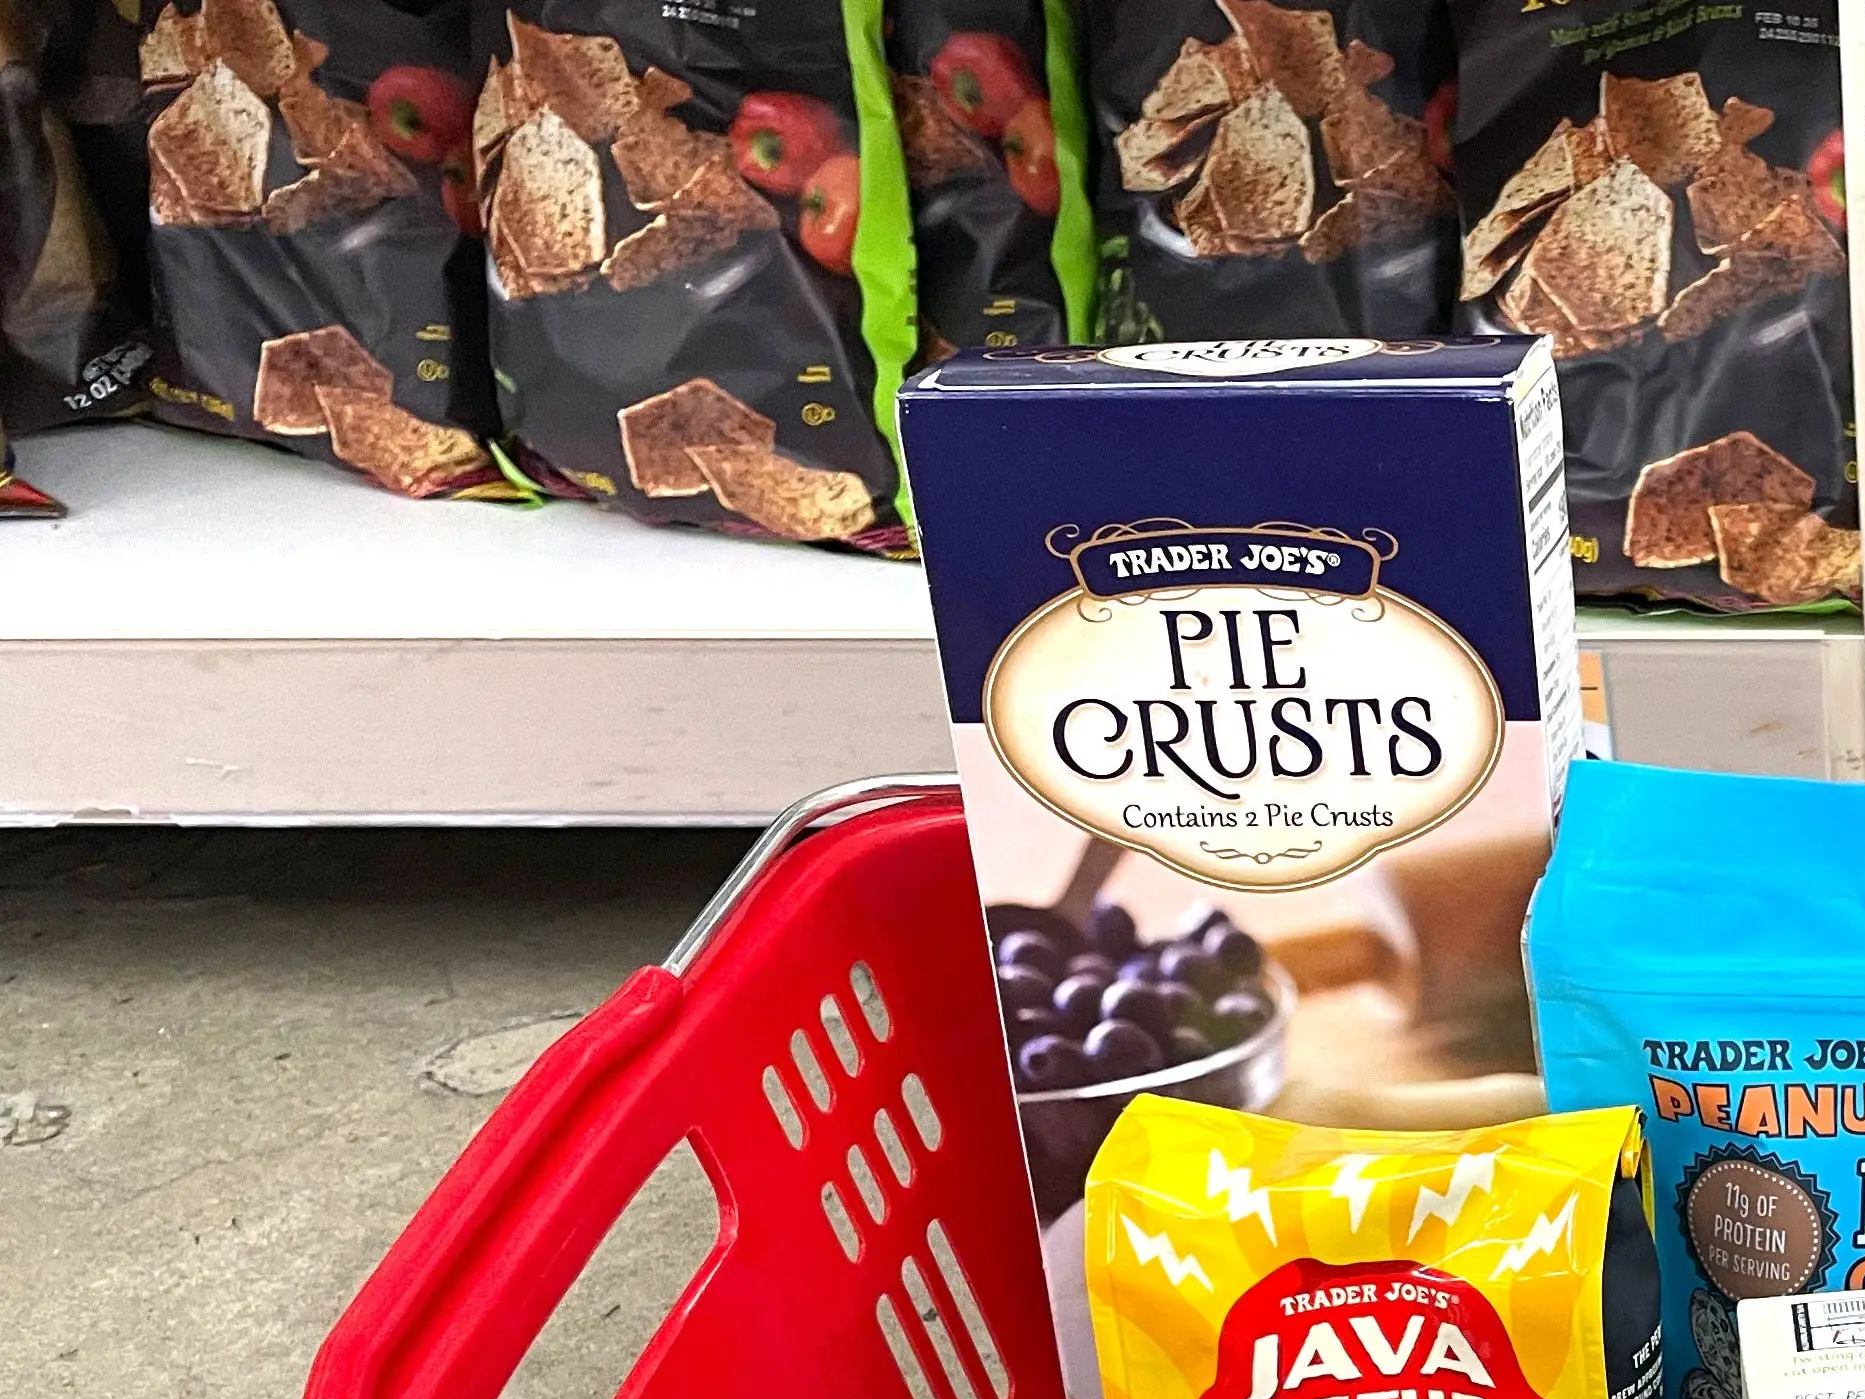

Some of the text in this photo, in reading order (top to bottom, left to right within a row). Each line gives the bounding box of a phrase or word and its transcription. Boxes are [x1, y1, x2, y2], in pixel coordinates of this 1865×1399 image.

[1134, 344, 1351, 363] CRUSTS
[1109, 545, 1232, 579] TRADER
[1160, 609, 1306, 691] PIE
[1052, 696, 1443, 800] CRUSTS
[1123, 803, 1393, 830] Contains 2 Pie Crusts
[1643, 1039, 1793, 1071] TRADER
[1725, 1182, 1778, 1218] 11g OF
[1714, 1214, 1786, 1254] PROTEIN
[1708, 1245, 1791, 1281] PER SERVING
[1279, 1283, 1378, 1316] TRADER
[1632, 1341, 1651, 1369] THE
[1811, 1363, 1850, 1375] open
